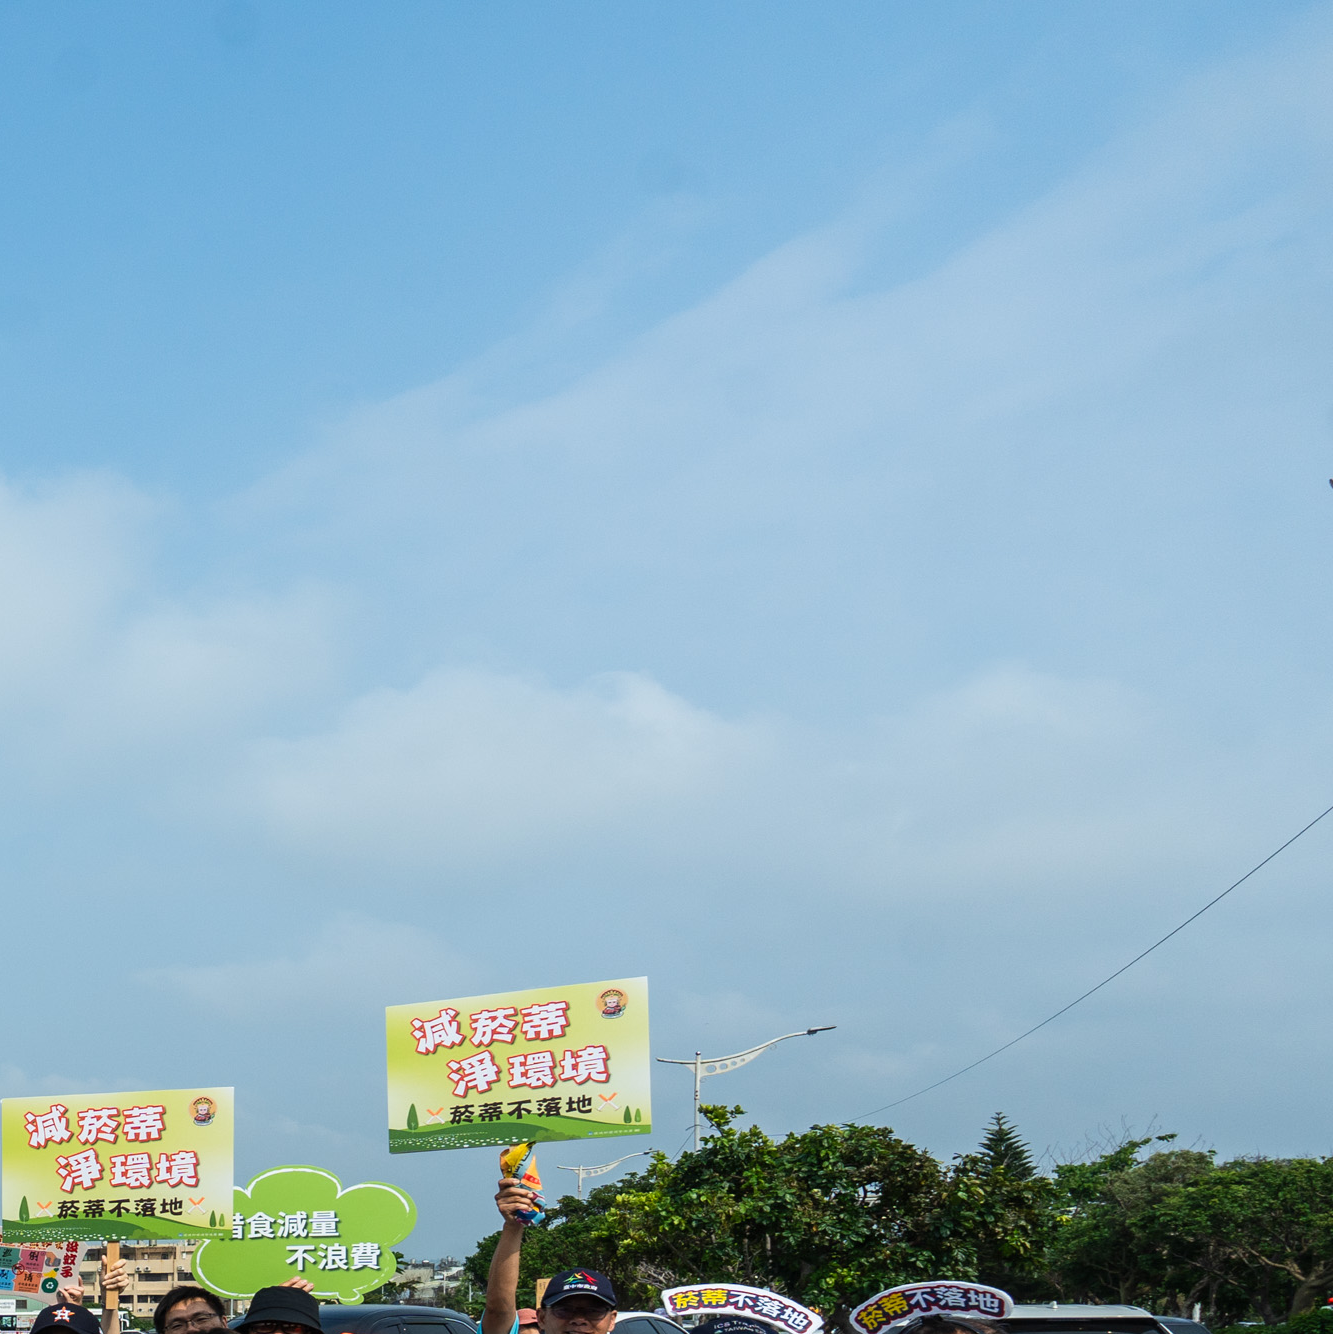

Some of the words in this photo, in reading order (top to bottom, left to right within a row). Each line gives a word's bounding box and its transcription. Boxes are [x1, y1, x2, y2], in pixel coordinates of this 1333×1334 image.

[410, 1001, 569, 1055] 減菸蒂
[446, 1045, 611, 1098] 淨環境
[24, 1104, 165, 1148] 減菸蒂
[449, 1095, 593, 1125] 菸蒂不落地
[55, 1148, 200, 1193] 淨環境
[57, 1197, 184, 1219] 菸蒂不落地
[286, 1242, 381, 1271] 不浪費
[671, 1288, 813, 1331] 菸蒂不落地
[858, 1286, 1000, 1330] 菸蒂不落地
